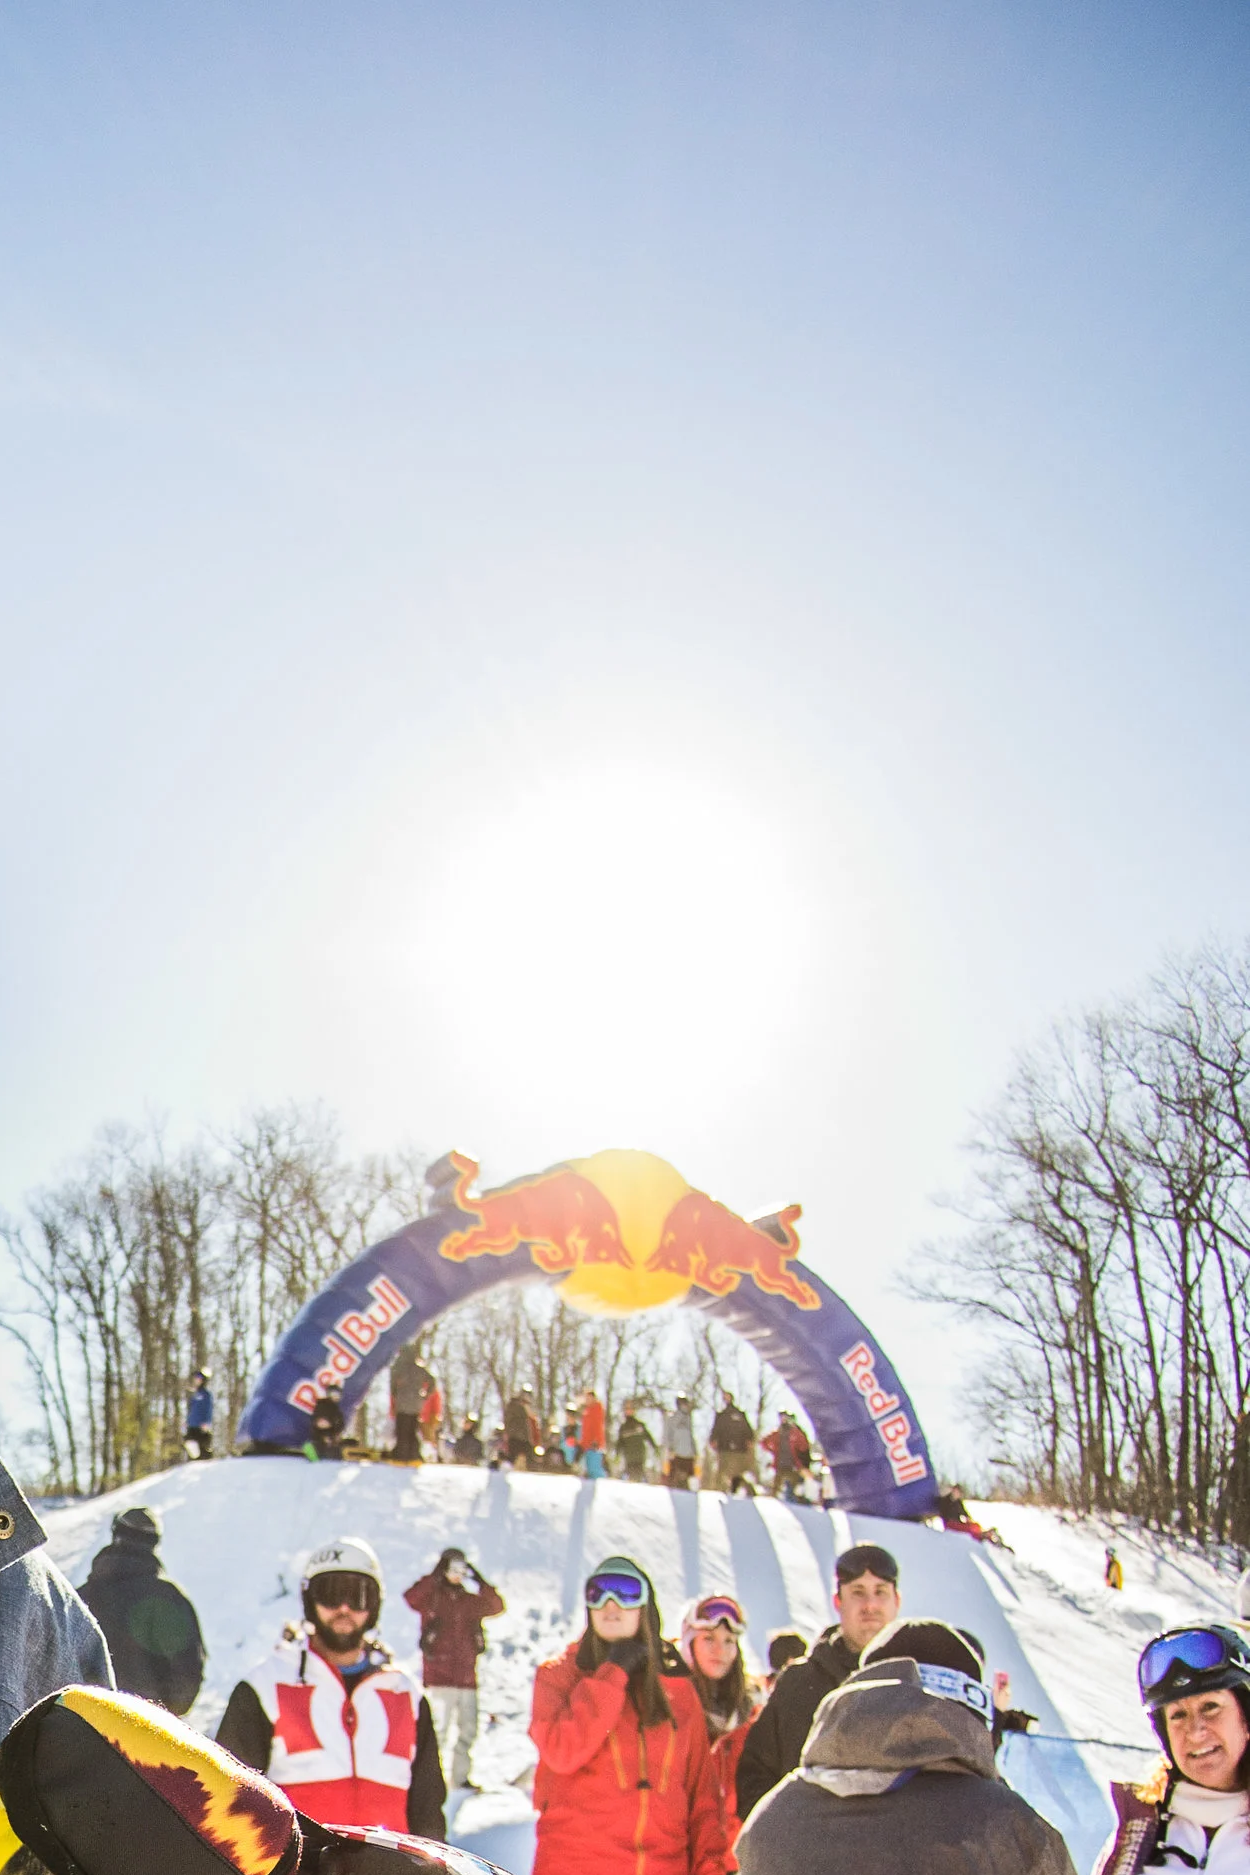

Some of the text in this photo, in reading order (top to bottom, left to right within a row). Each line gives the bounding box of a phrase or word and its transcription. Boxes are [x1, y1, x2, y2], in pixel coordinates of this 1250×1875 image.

[335, 1274, 412, 1355] Bull
[839, 1341, 927, 1486] Red Bull
